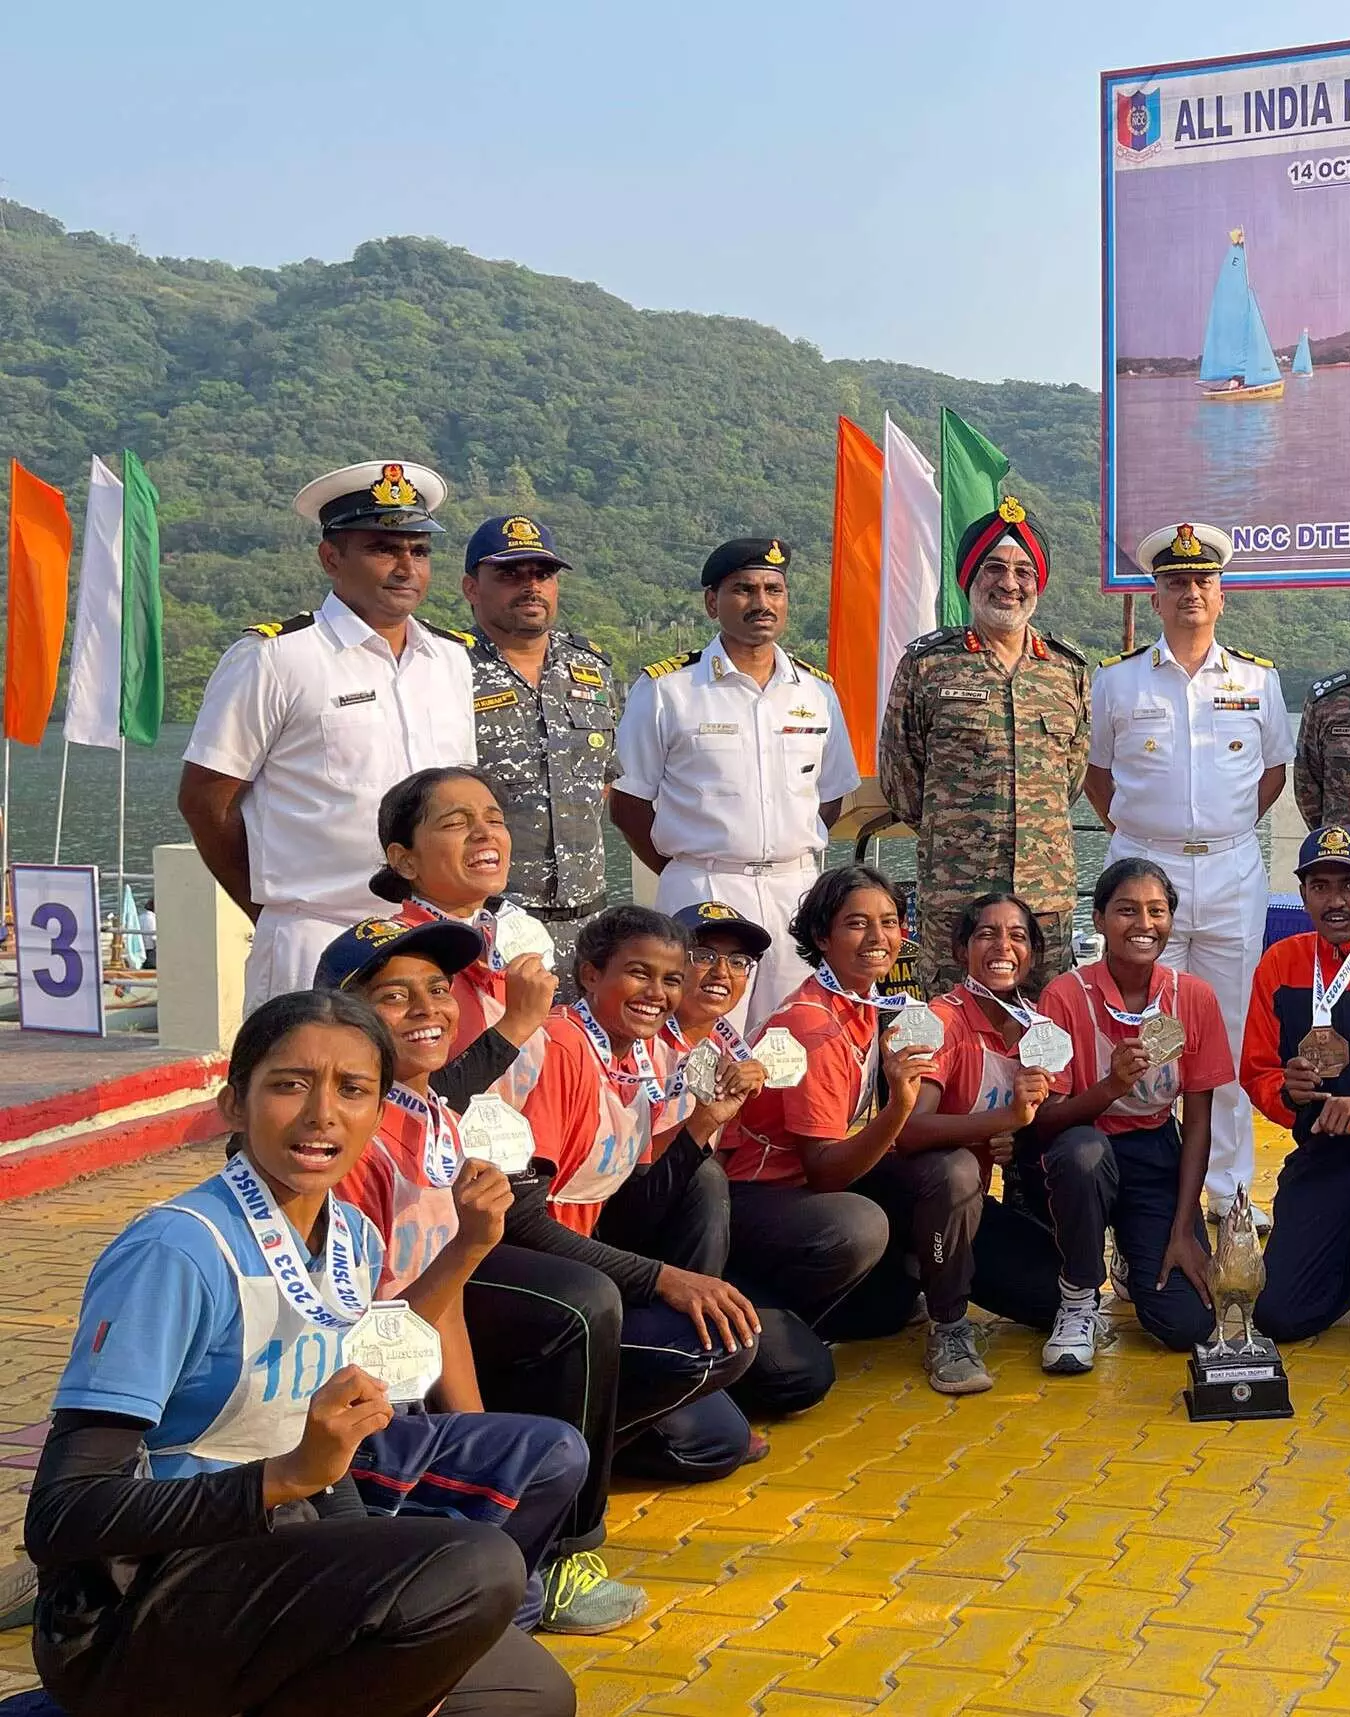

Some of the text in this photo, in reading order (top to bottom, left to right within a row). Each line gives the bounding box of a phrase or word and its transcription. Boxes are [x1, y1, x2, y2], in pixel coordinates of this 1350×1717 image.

[1175, 95, 1233, 142] ALL
[1244, 82, 1333, 134] INDIA
[1290, 164, 1313, 184] 14
[1233, 526, 1289, 550] NCC
[1297, 522, 1350, 549] DTE
[31, 902, 84, 998] 3
[386, 1087, 429, 1114] AINS
[231, 1169, 273, 1221] AINSC
[274, 1253, 314, 1304] 2023
[332, 1240, 351, 1285] AINSC
